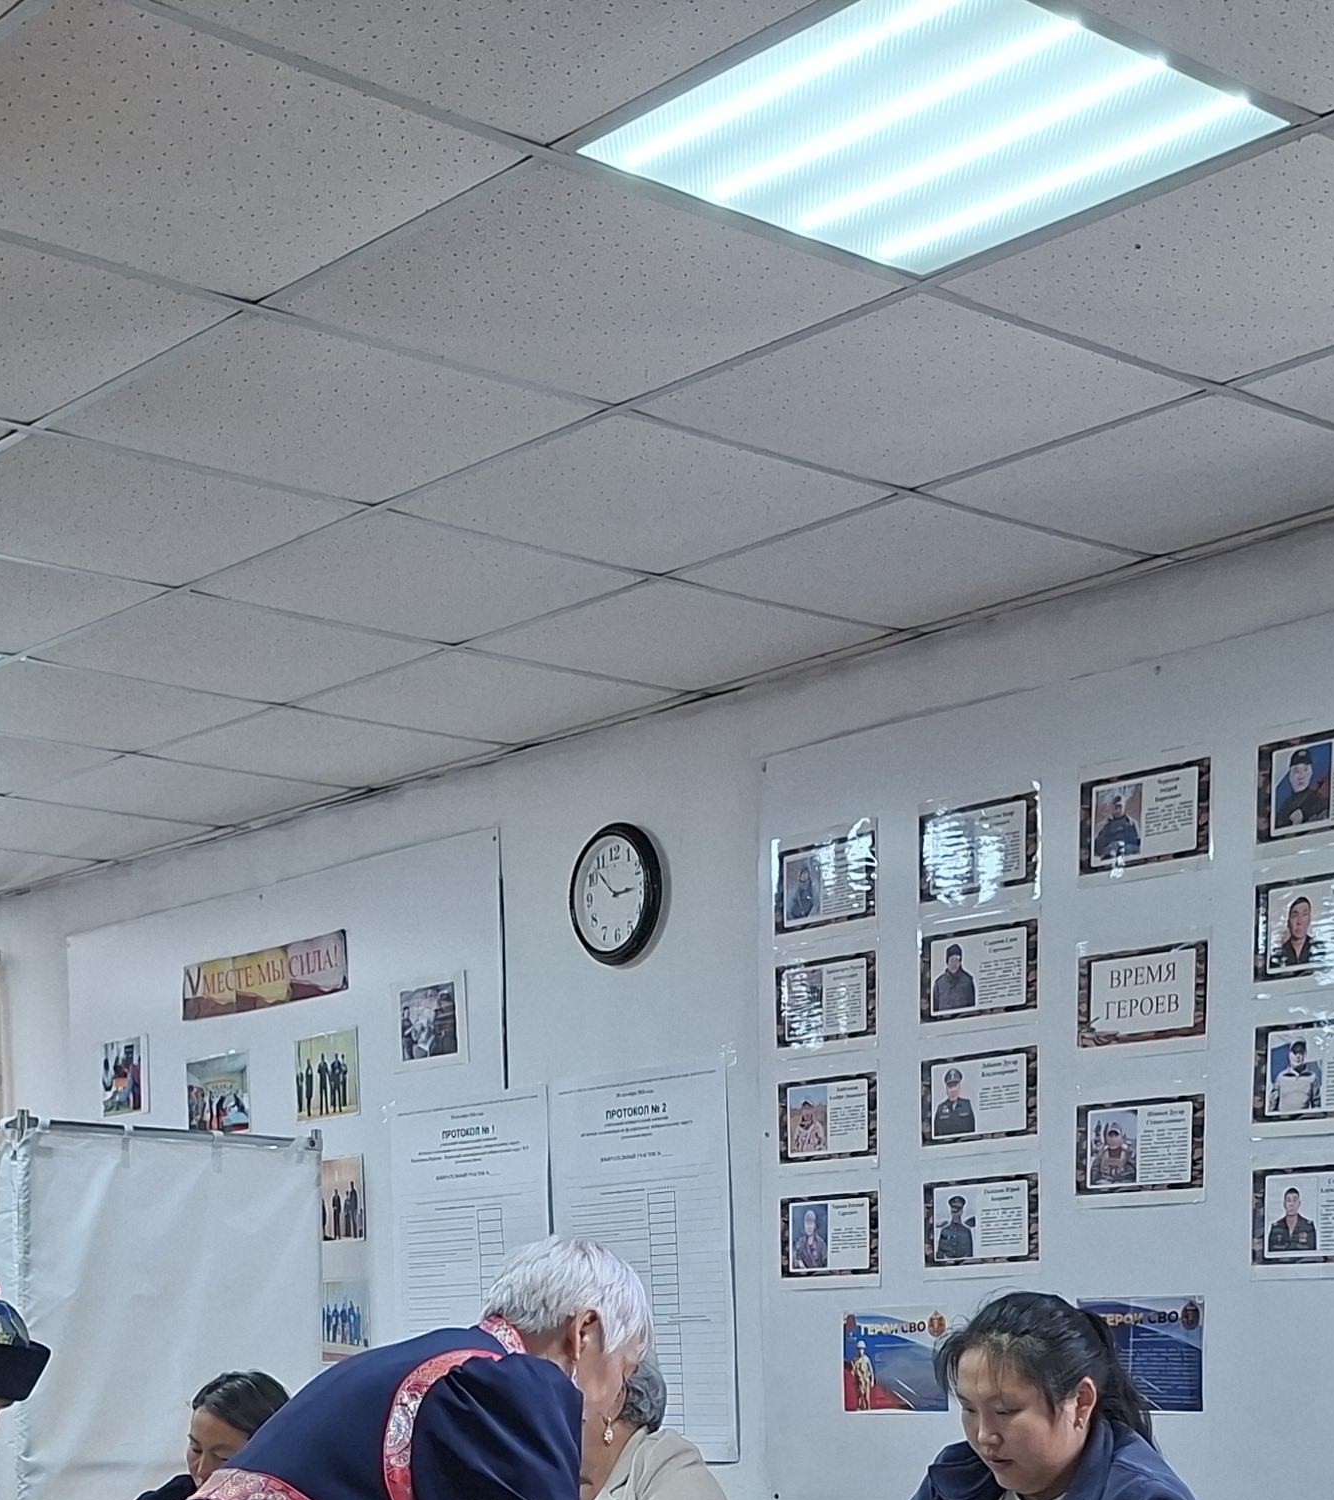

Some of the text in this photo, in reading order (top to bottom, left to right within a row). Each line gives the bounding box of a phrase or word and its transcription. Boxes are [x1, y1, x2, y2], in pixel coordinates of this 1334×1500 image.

[609, 844, 621, 862] 12
[625, 847, 631, 862] 1
[595, 853, 606, 870] 11
[634, 859, 642, 876] 2
[588, 871, 599, 887] 10
[586, 893, 594, 909] 9
[591, 912, 598, 928] 8
[627, 920, 634, 935] 5
[601, 925, 608, 942] 7
[614, 927, 621, 943] 6
[257, 958, 286, 986] МЫ
[288, 943, 340, 978] СИЛА!
[1109, 962, 1177, 989] ВРЕМЯ
[1105, 993, 1180, 1020] ГЕРОЕВ
[605, 1102, 667, 1120] ПРОТОКОЛ № 2
[441, 1124, 495, 1140] ПРОТОКОЛ № 1
[1147, 1310, 1179, 1324] СВО
[859, 1320, 927, 1336] ГЕРОИ СВО
